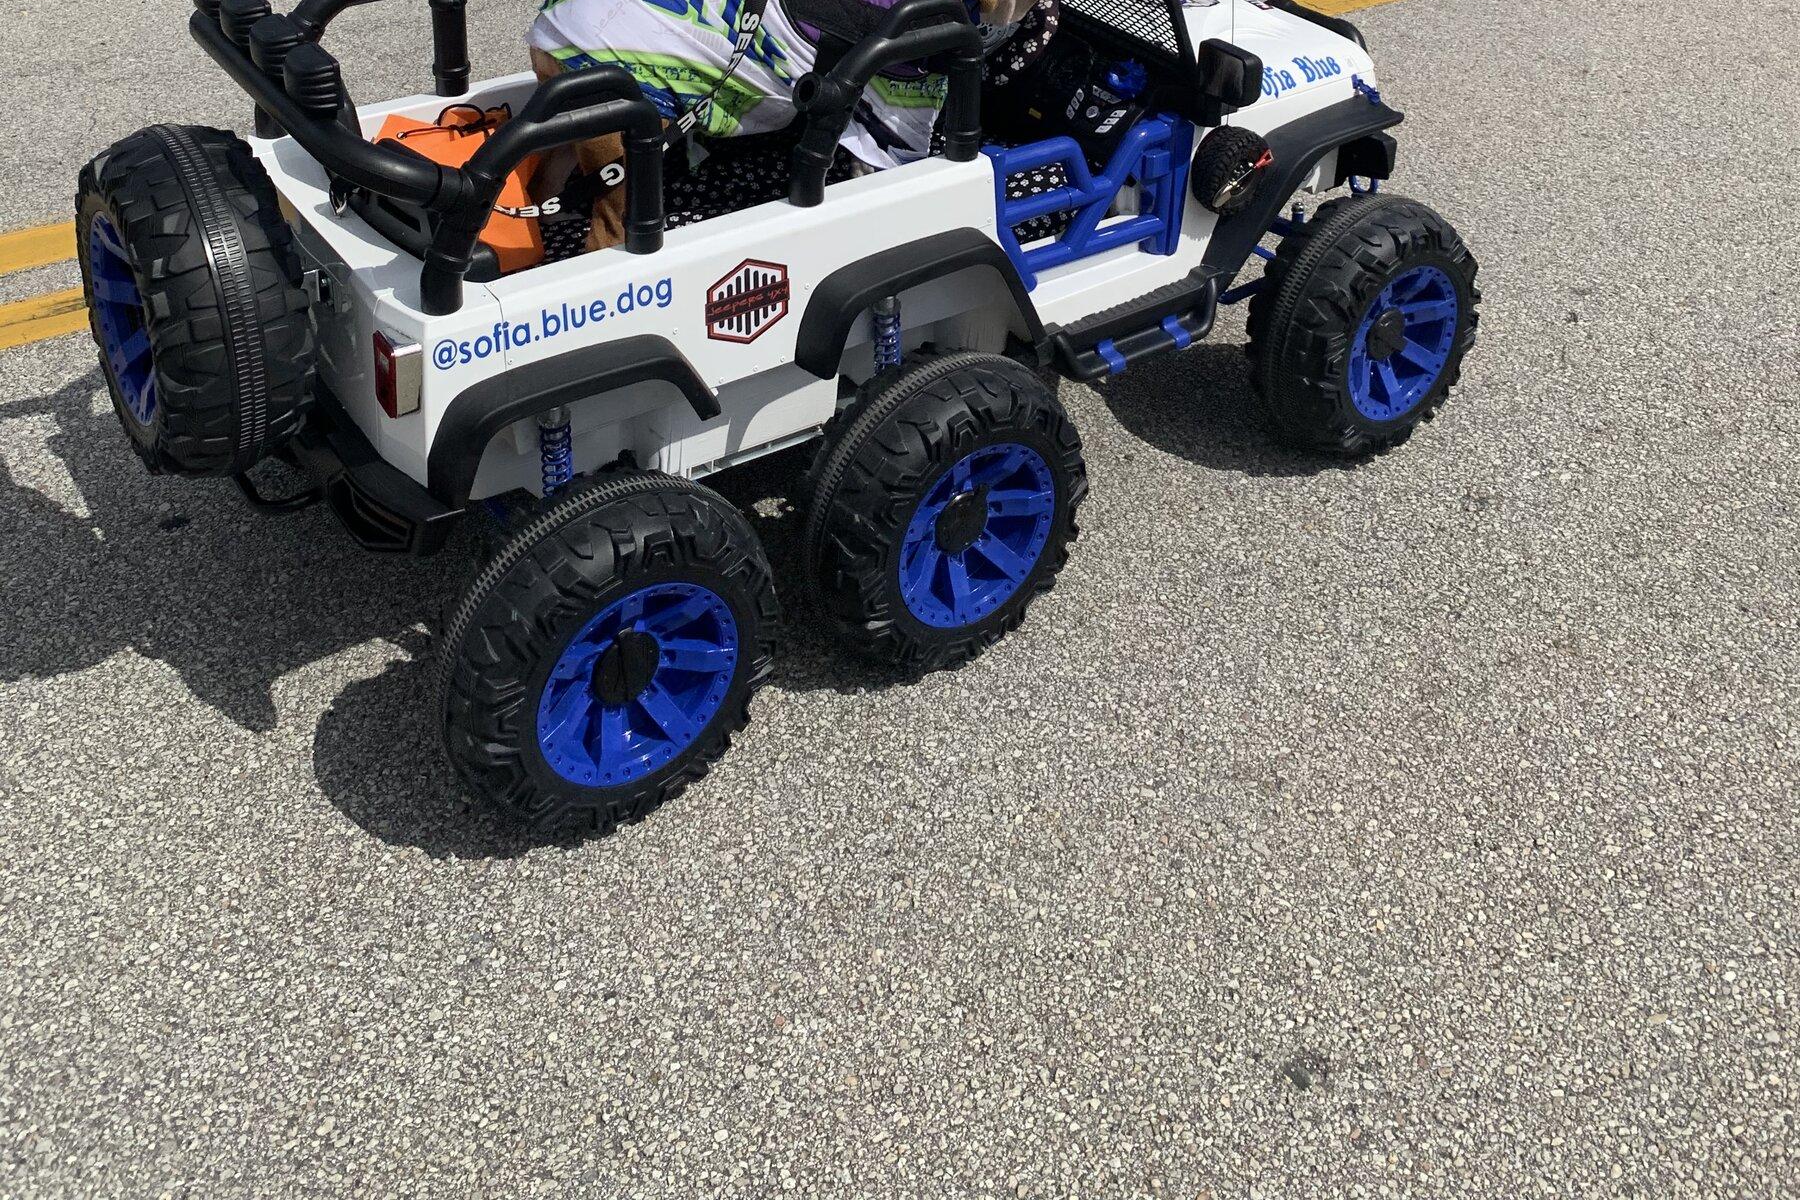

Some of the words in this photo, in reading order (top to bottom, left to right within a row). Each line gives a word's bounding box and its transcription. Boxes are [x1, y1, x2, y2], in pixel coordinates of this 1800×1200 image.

[1261, 66, 1297, 99] ofia
[1292, 56, 1341, 83] Blue
[433, 277, 673, 370] @sofia.blue.dog
